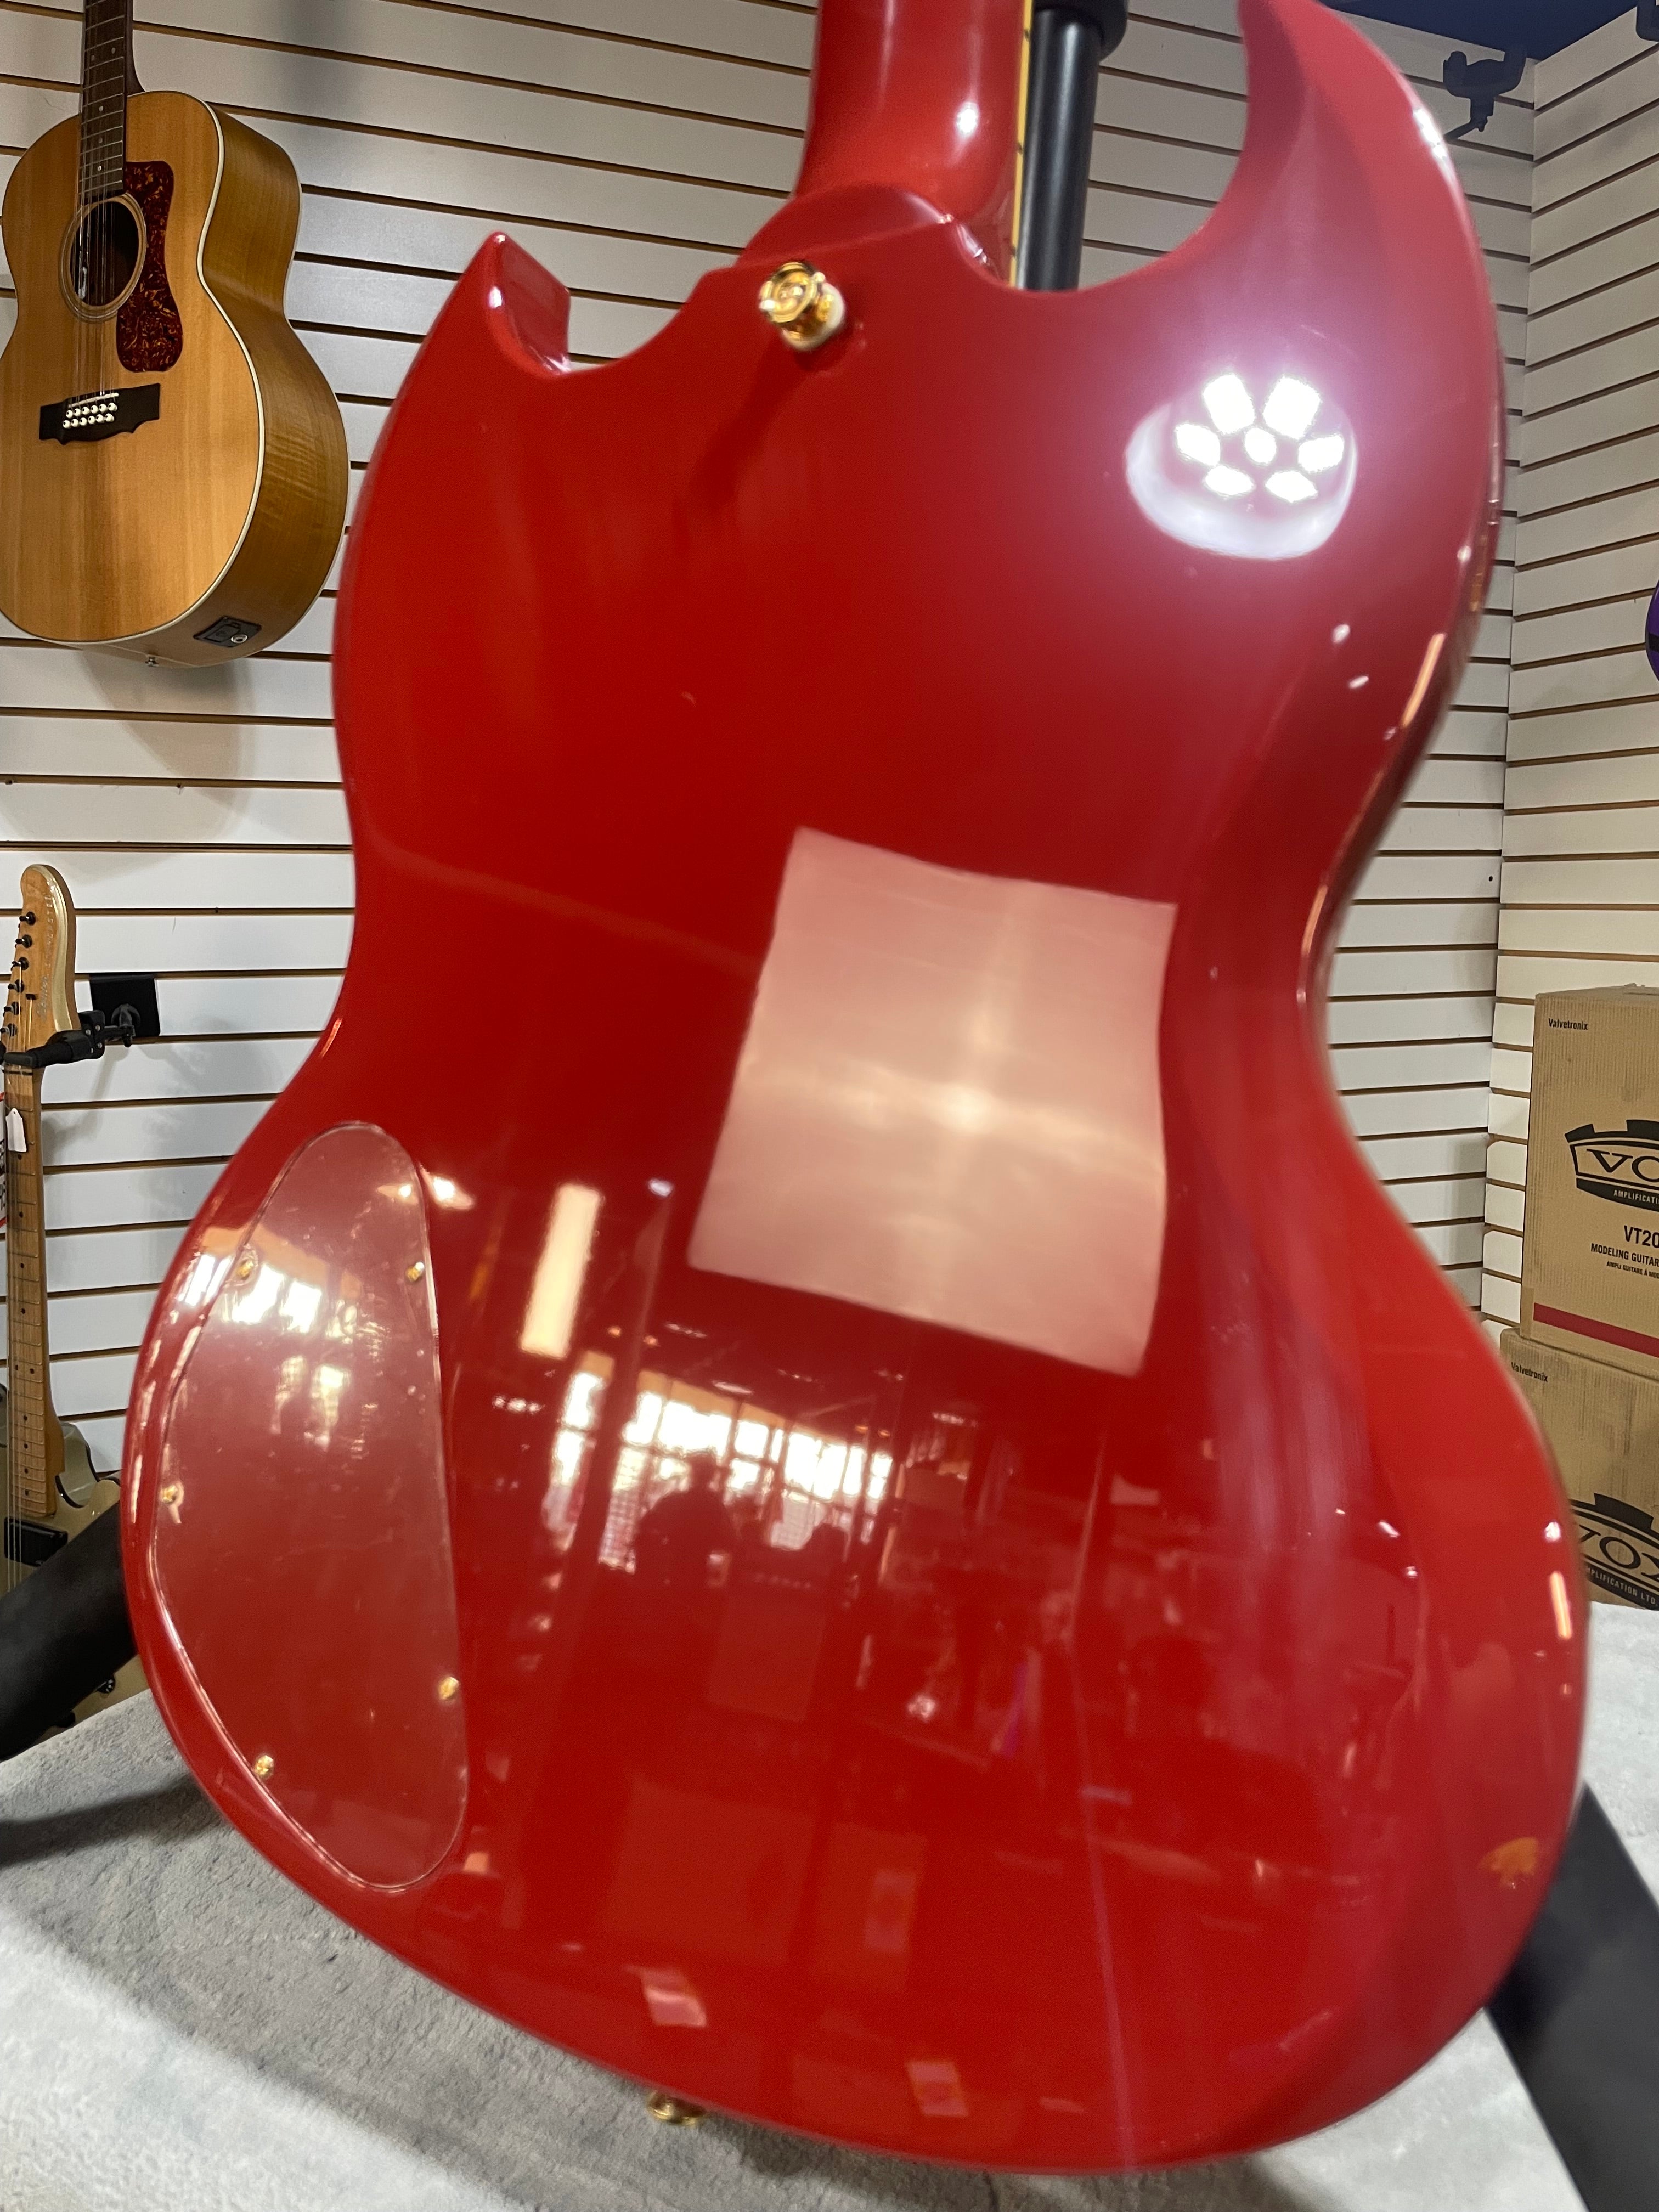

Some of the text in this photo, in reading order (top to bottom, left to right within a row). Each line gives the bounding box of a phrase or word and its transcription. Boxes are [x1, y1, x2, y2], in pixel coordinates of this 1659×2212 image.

[1548, 1018, 1588, 1030] Valvetronix
[1613, 1189, 1659, 1205] AMPLIFICATI
[1624, 1225, 1659, 1249] VT20
[1590, 1243, 1659, 1267] MODELING GUITAR
[1606, 1261, 1622, 1269] AMPLI
[1622, 1265, 1643, 1276] GUITARE
[1511, 1362, 1548, 1383] Valvetronix
[1587, 1567, 1638, 1597] PLIFICATION
